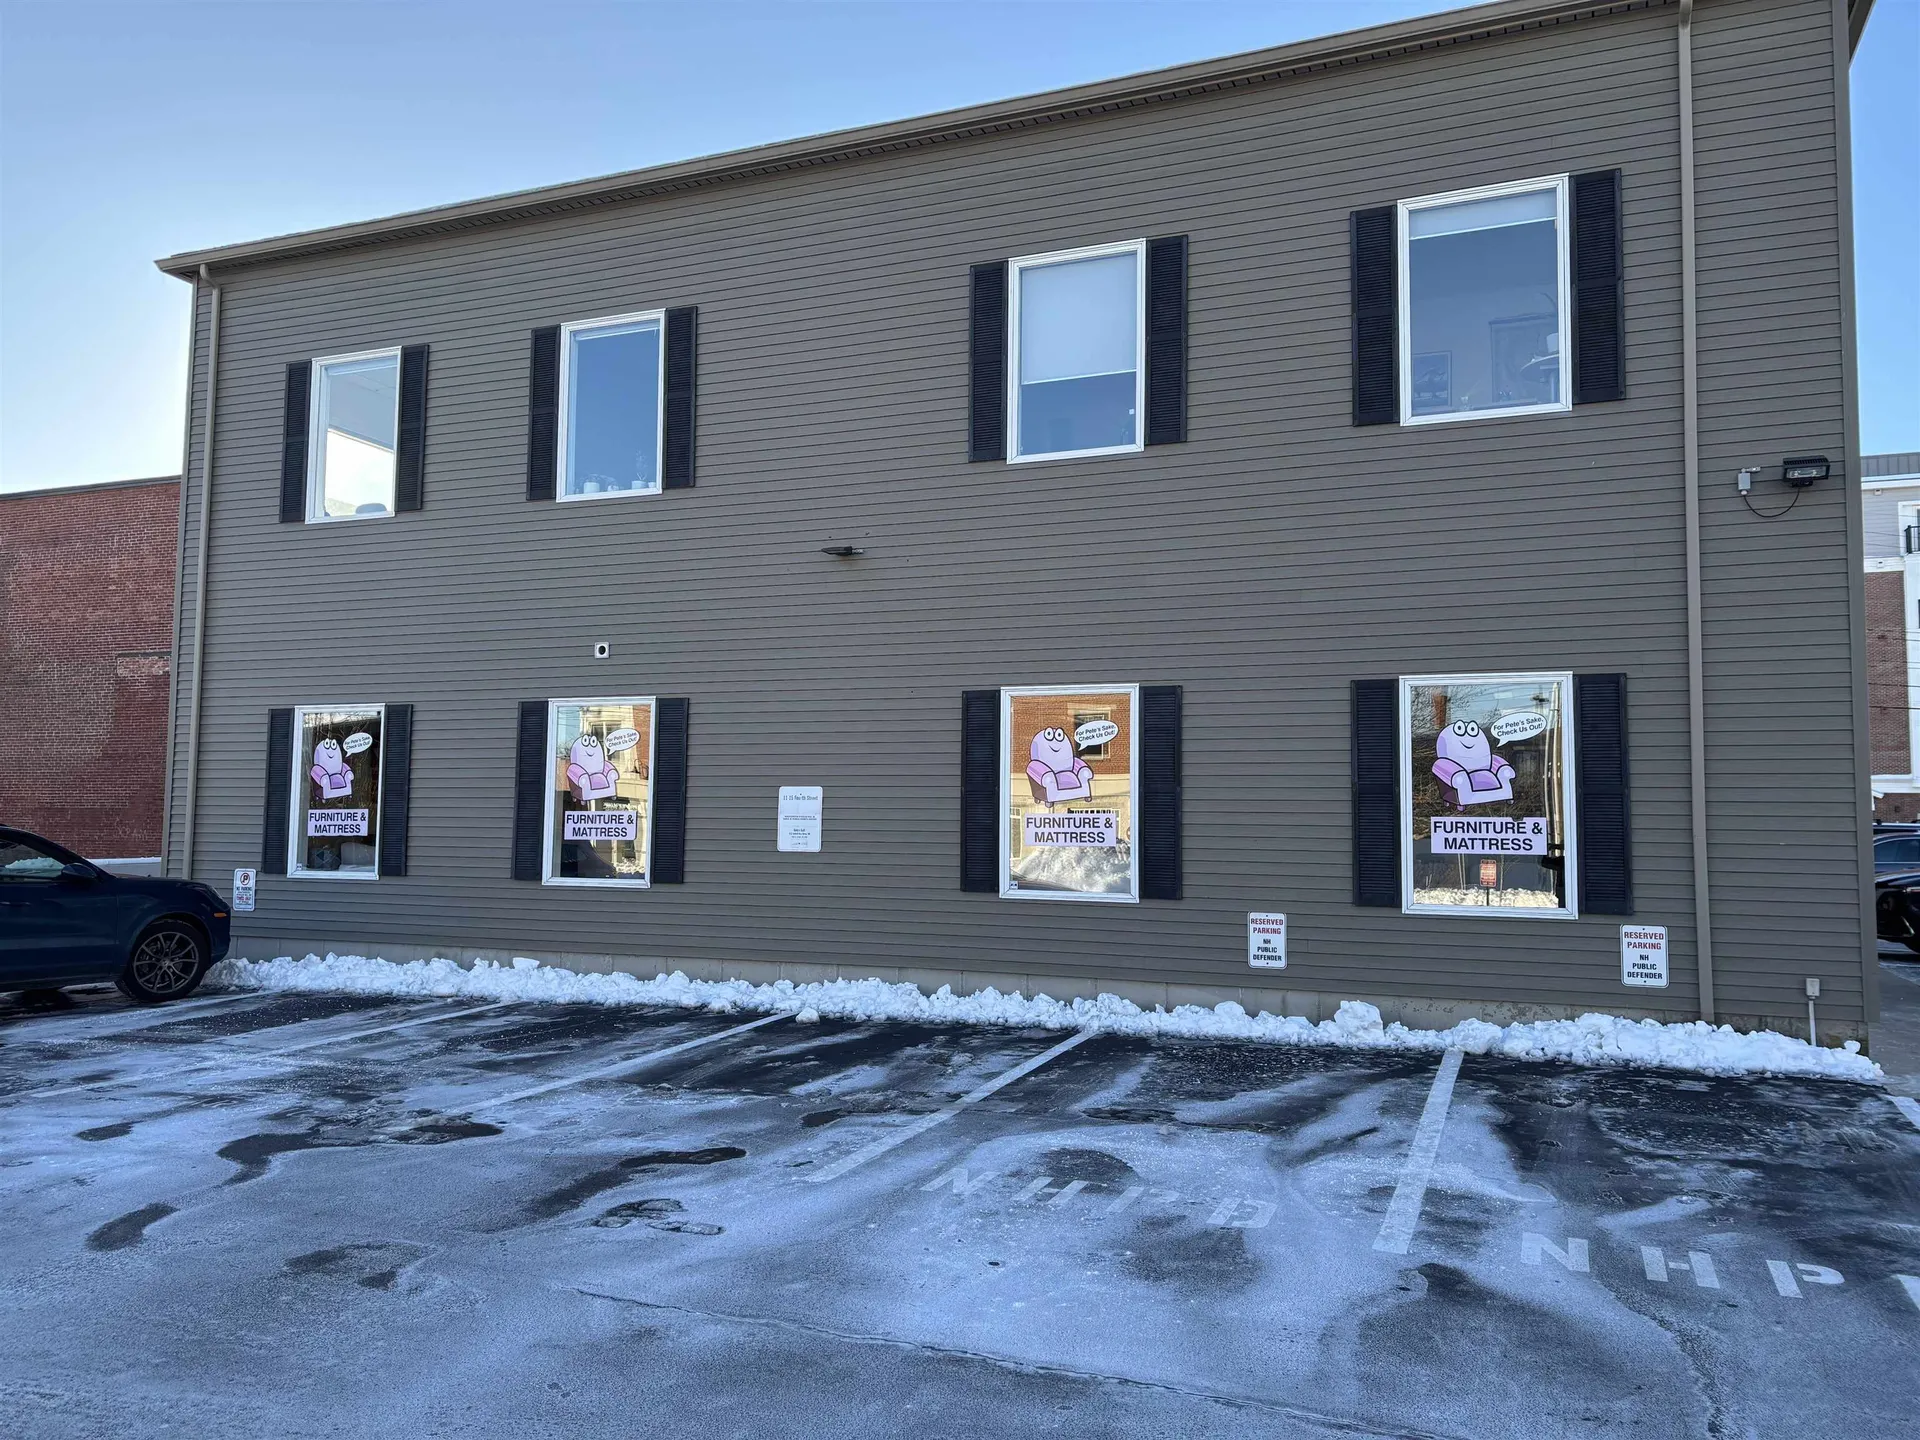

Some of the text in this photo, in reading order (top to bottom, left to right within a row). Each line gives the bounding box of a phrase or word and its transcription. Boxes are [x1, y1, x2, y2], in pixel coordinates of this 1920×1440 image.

[1496, 728, 1517, 737] Check
[309, 812, 366, 822] FURNITURE &
[566, 814, 634, 825] FURNITURE &
[1026, 817, 1113, 829] FURNITURE &
[314, 824, 361, 833] MATTRESS
[572, 827, 628, 837] MATTRESS
[1433, 821, 1543, 835] FURNITURE &
[1034, 831, 1106, 843] MATTRESS
[1444, 837, 1533, 851] MATTRESS
[1251, 918, 1283, 926] RESERVED
[1624, 931, 1664, 940] RESERVED
[1627, 942, 1661, 950] PARKING
[1632, 962, 1657, 970] PUBLIC
[1627, 971, 1663, 979] DEFENDER
